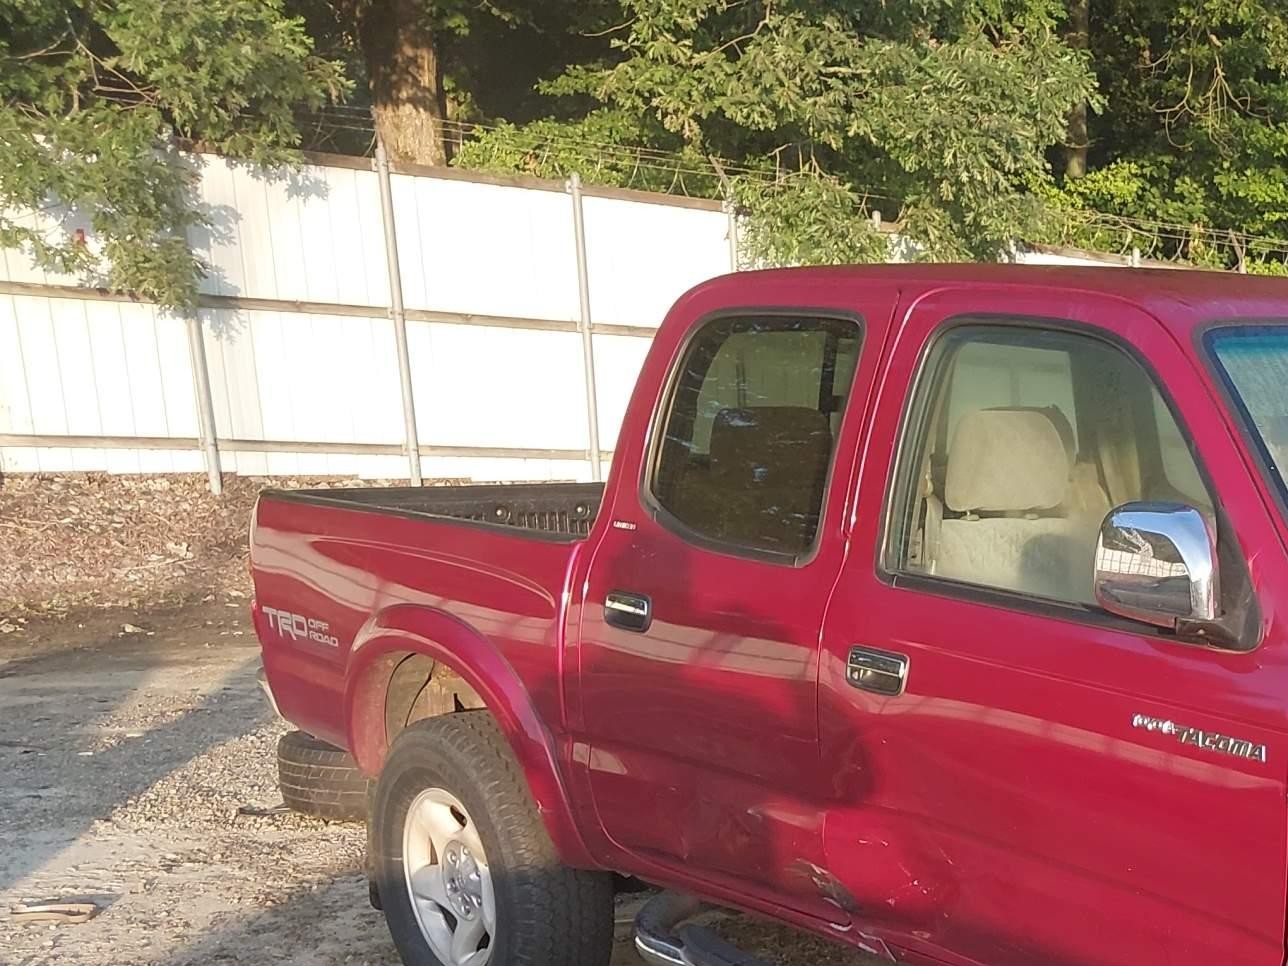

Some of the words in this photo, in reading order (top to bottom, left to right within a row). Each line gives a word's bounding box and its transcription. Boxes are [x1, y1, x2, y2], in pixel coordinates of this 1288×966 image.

[262, 605, 307, 641] TRD
[308, 618, 329, 631] OFF
[309, 630, 338, 647] ROAD
[1176, 725, 1267, 763] TACOMA
